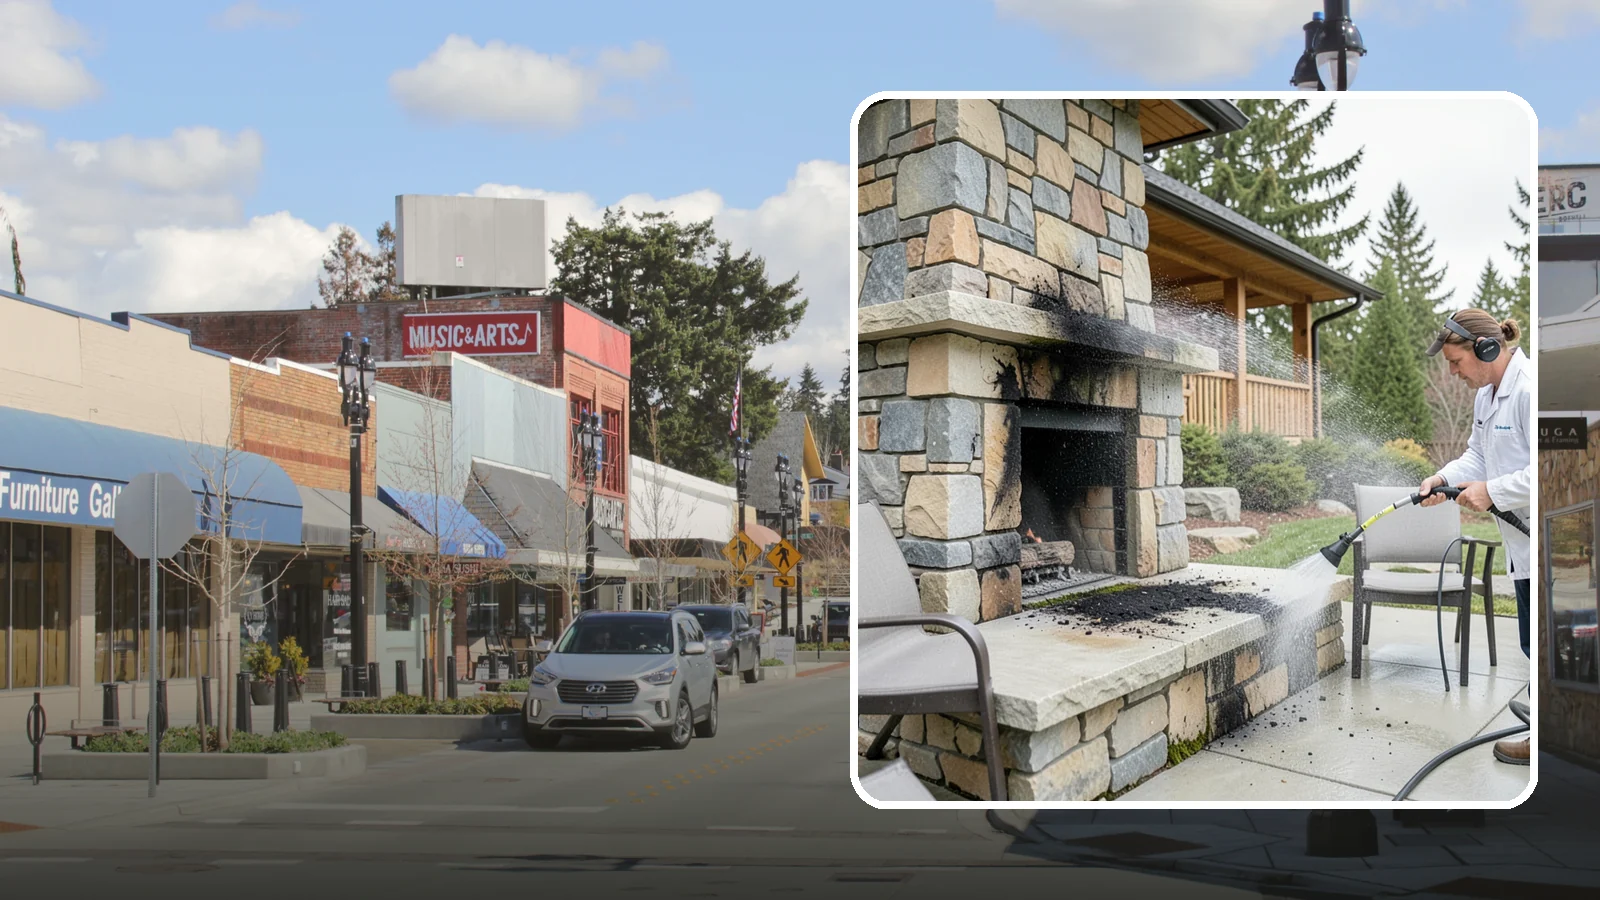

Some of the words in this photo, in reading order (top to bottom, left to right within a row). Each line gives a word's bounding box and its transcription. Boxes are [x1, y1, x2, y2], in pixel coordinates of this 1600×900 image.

[0, 471, 80, 516] Furniture
[89, 482, 122, 520] Gal
[453, 564, 479, 574] SUSHI
